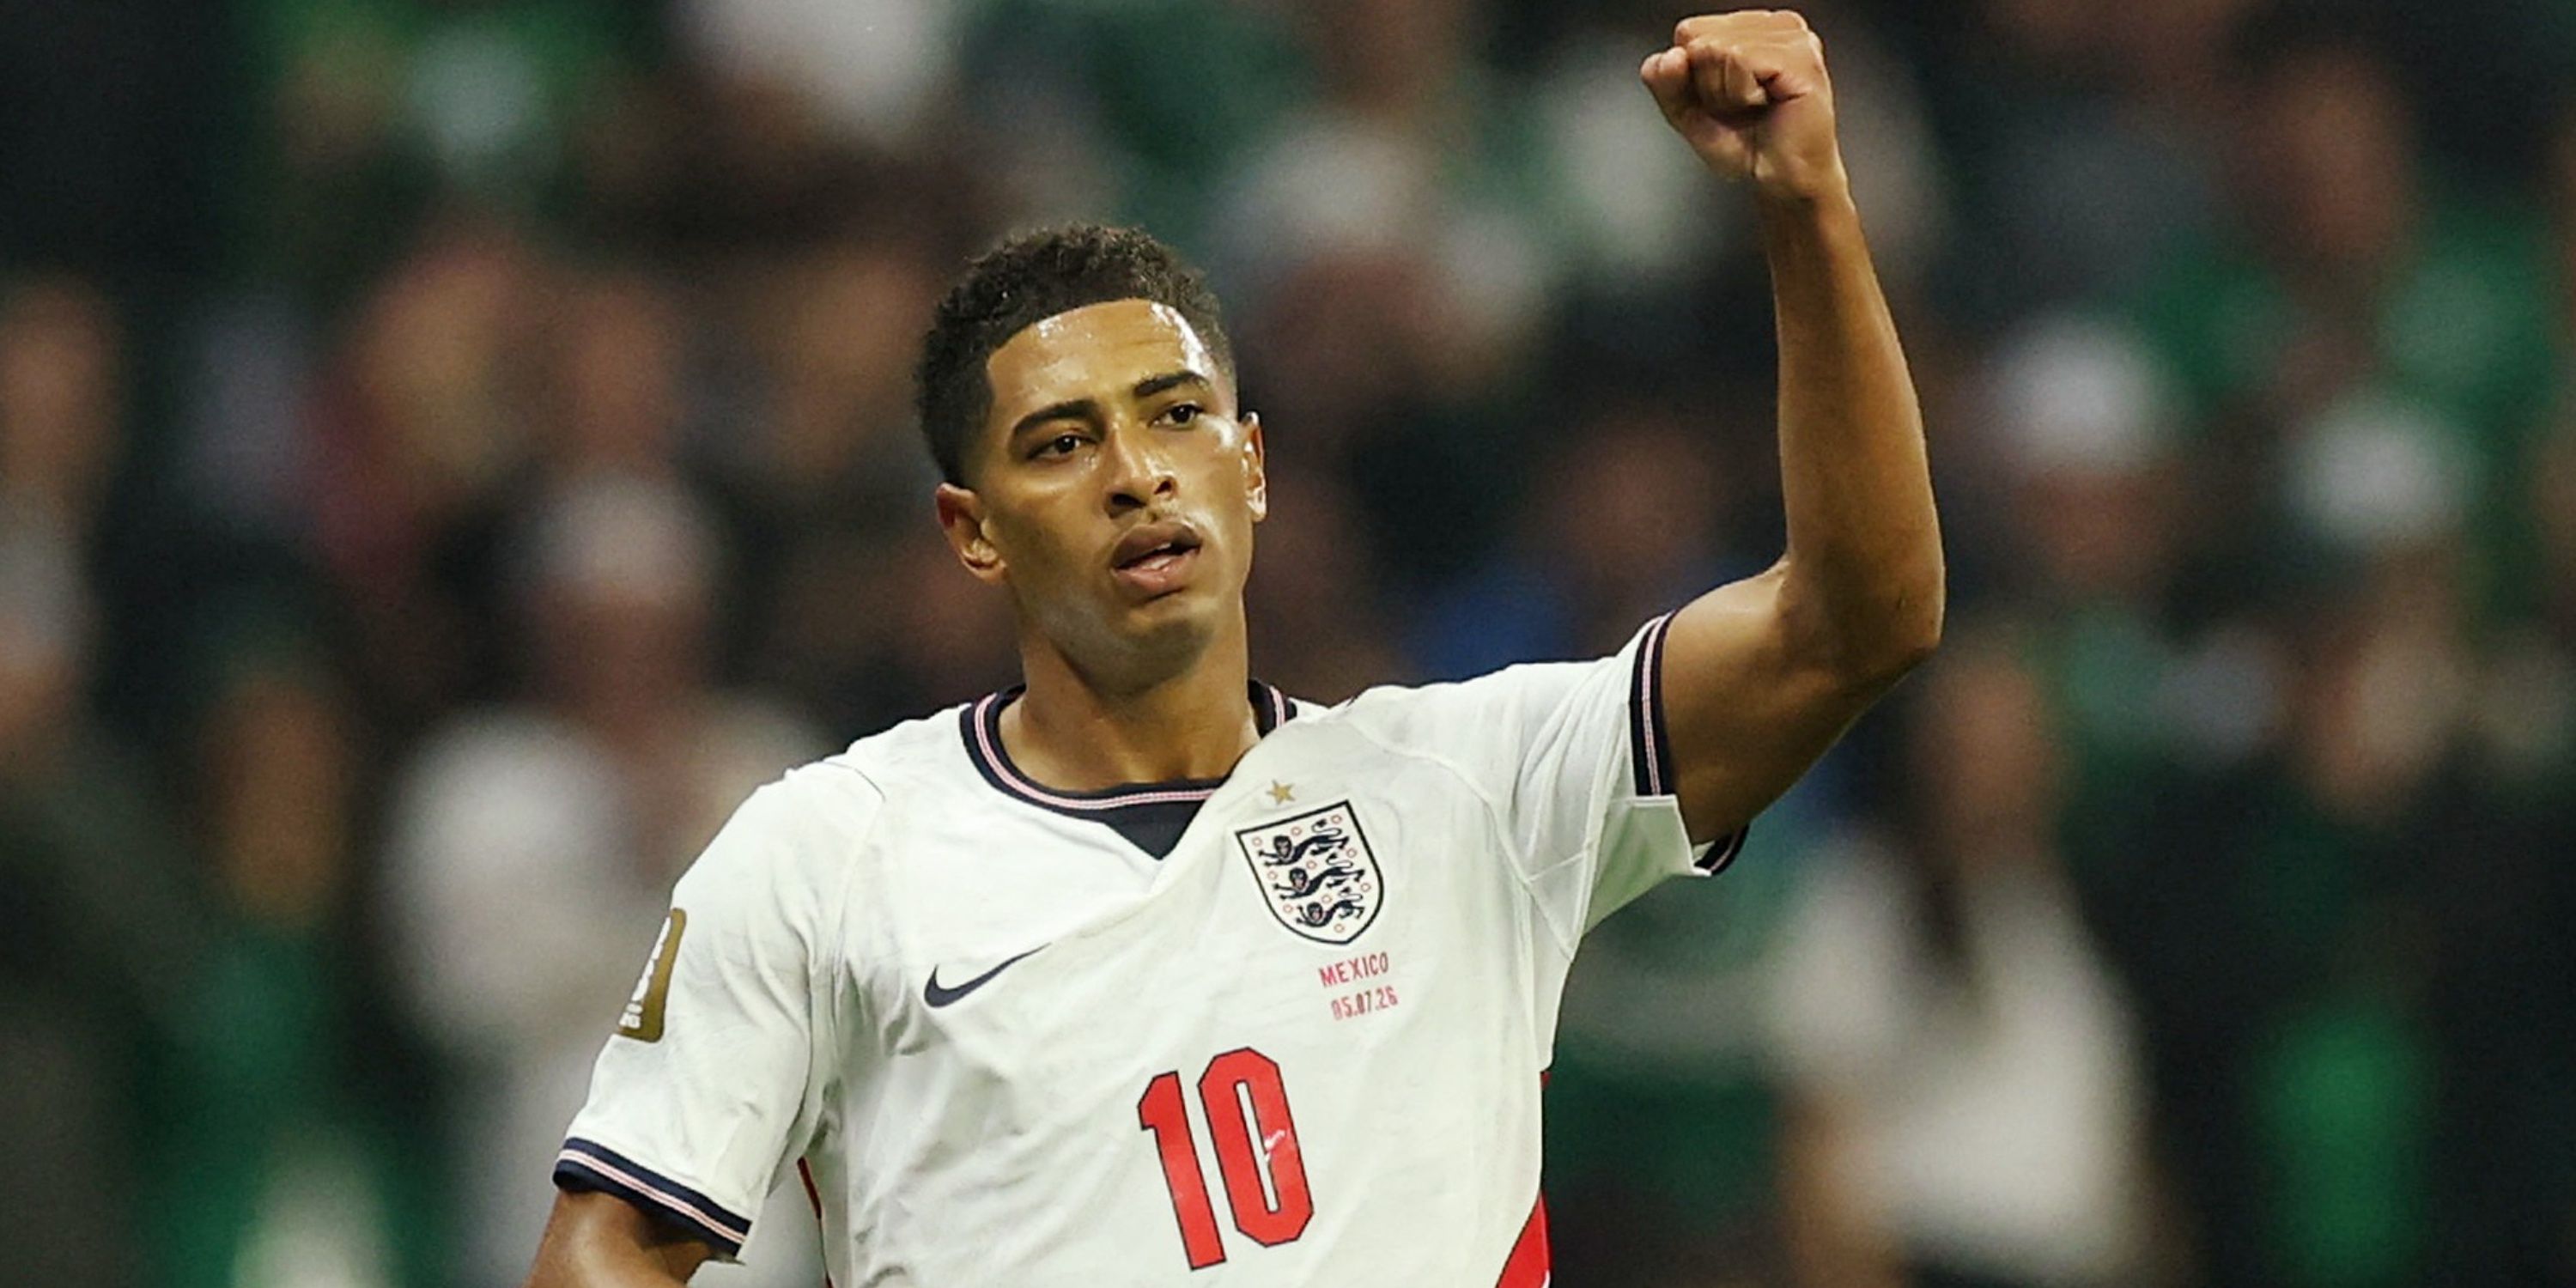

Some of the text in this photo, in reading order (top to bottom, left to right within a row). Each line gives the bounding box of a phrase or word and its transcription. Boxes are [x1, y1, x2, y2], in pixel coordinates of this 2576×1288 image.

[1319, 951, 1388, 987] MEXICO
[1331, 986, 1398, 1020] 05.07.26
[1137, 1047, 1314, 1271] 10
